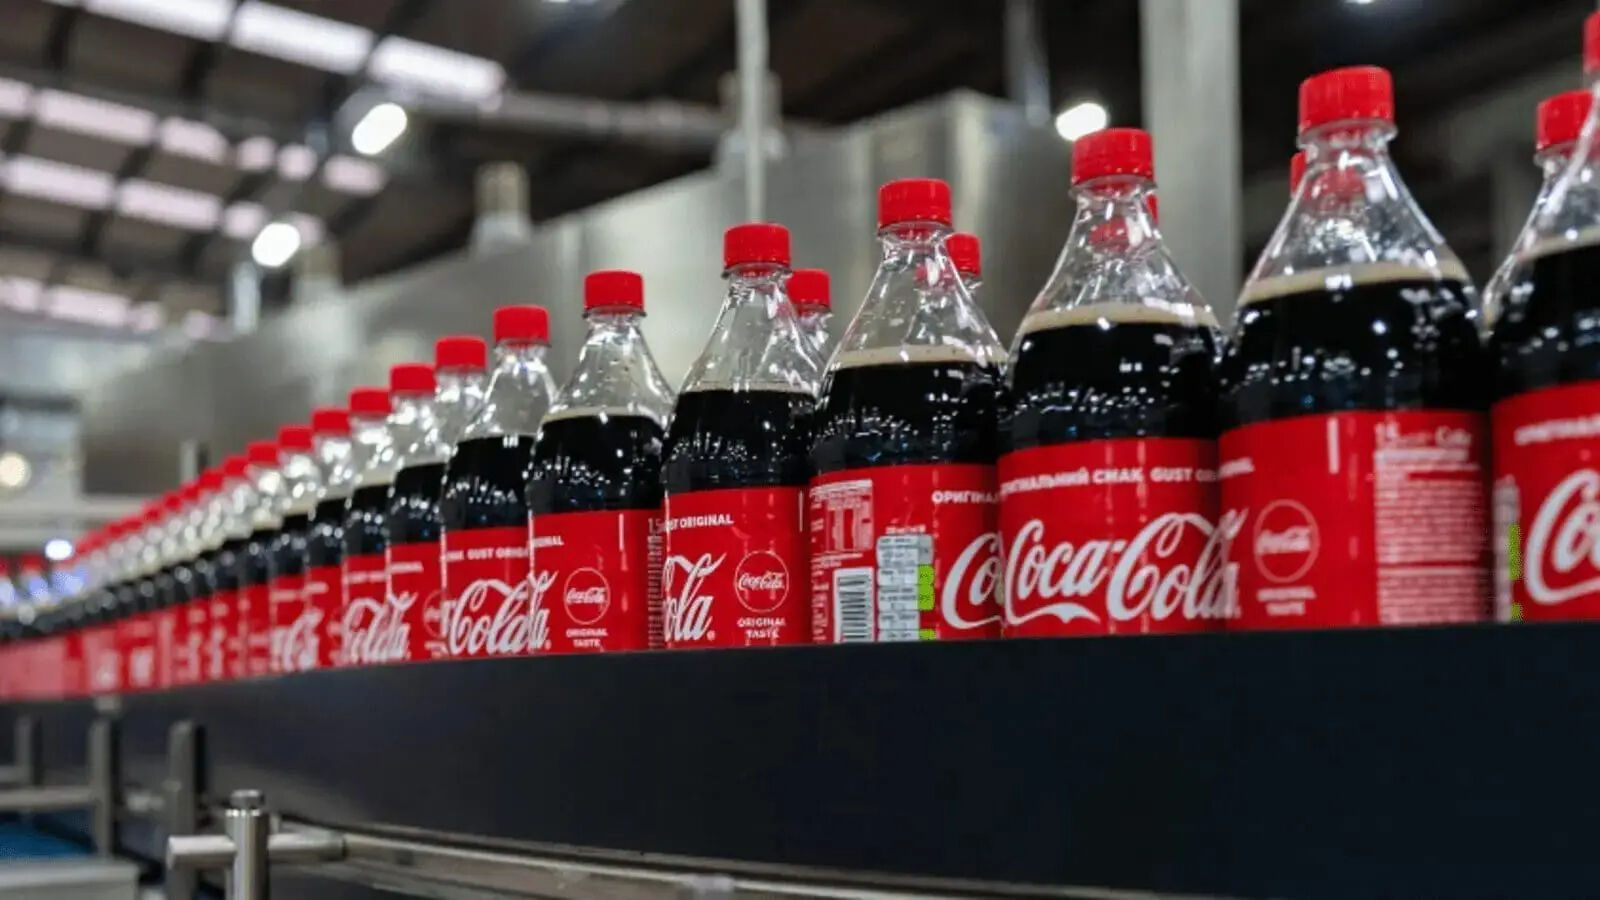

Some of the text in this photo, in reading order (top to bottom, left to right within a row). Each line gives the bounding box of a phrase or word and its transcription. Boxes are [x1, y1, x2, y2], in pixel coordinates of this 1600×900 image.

[680, 514, 734, 528] ORIGINAL
[736, 616, 786, 629] ORIGINAL
[745, 629, 780, 641] TASTE
